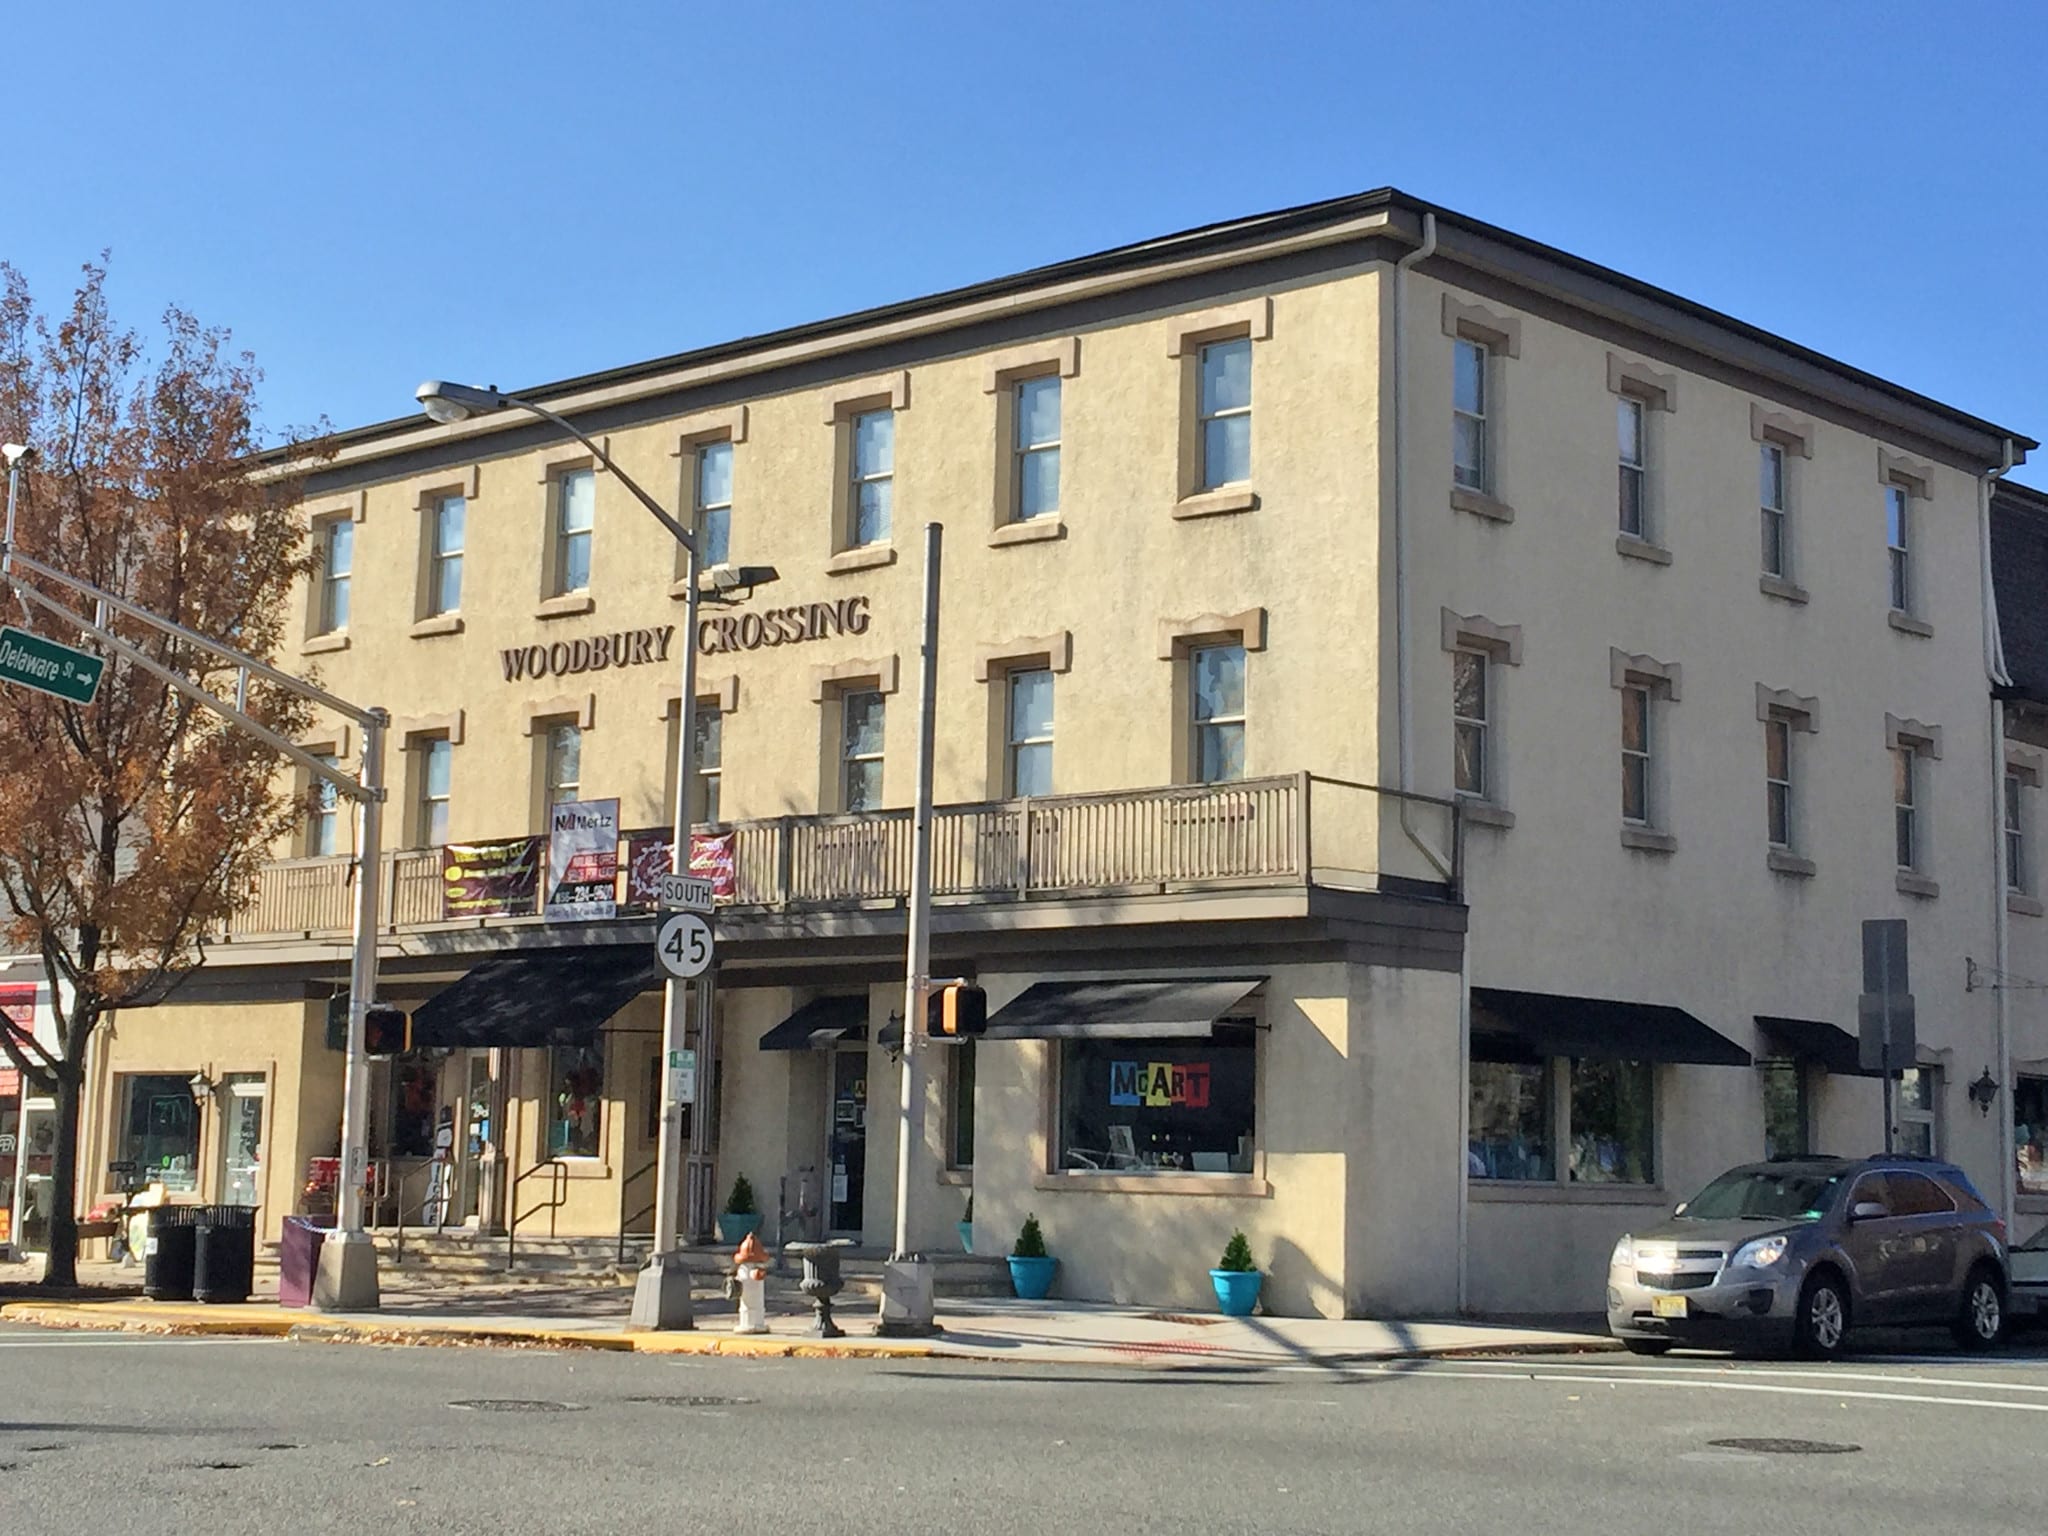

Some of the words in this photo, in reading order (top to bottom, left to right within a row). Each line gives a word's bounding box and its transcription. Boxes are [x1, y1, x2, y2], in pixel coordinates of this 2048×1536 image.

[501, 625, 675, 682] WOODBURY
[697, 596, 870, 656] CROSSING
[0, 640, 60, 681] Delaware
[62, 660, 75, 679] St
[665, 881, 711, 904] SOUTH
[664, 927, 706, 964] 45
